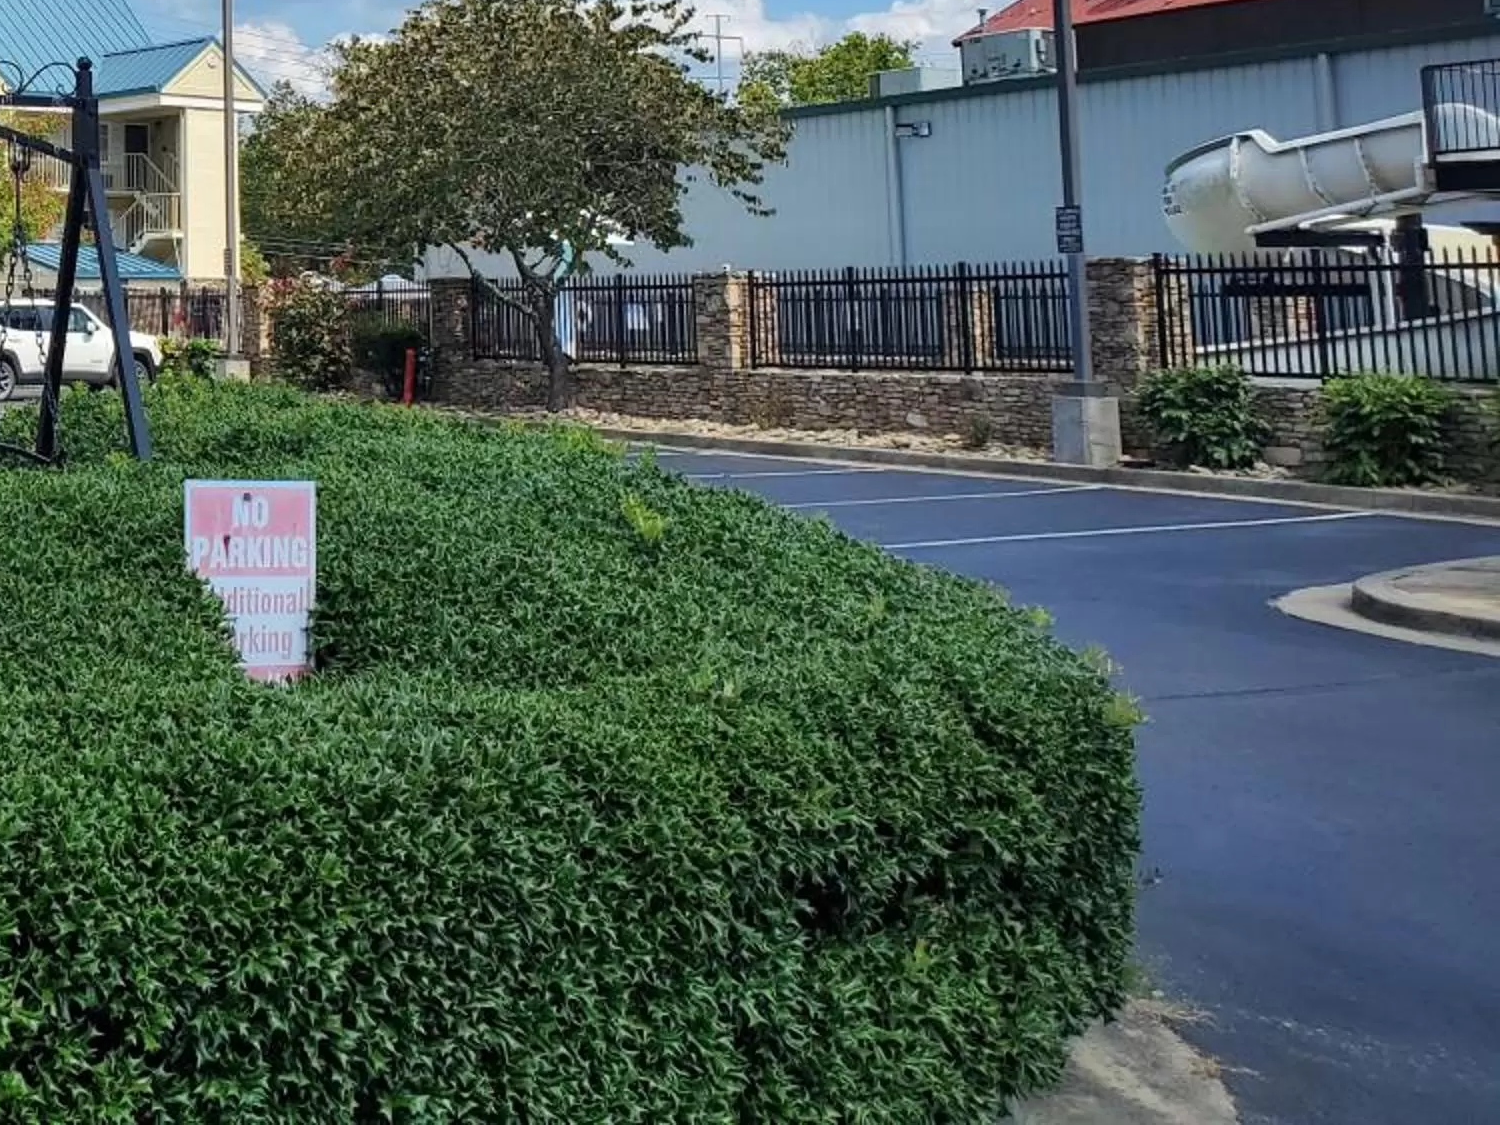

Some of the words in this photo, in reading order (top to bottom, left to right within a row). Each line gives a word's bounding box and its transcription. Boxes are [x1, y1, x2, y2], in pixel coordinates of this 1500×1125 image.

[231, 493, 270, 529] NO
[191, 534, 308, 568] PARKING
[220, 586, 303, 614] ditional
[236, 624, 293, 660] rking
